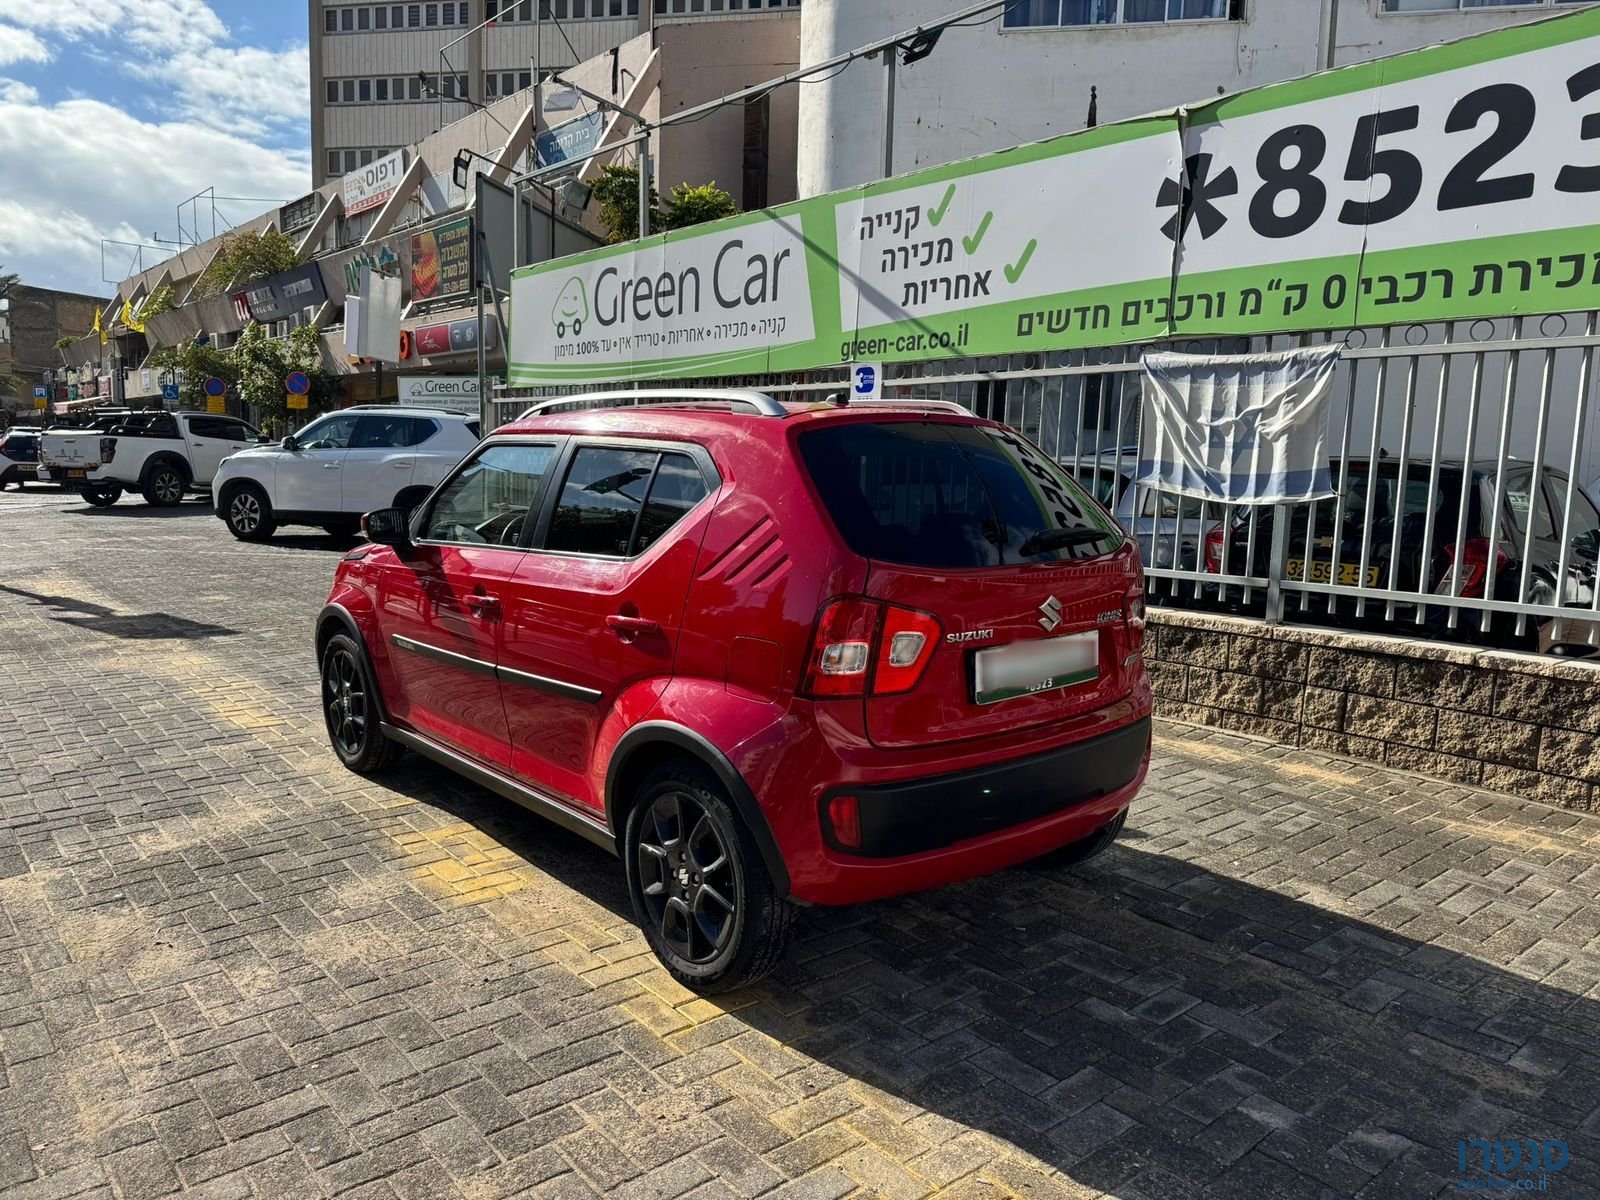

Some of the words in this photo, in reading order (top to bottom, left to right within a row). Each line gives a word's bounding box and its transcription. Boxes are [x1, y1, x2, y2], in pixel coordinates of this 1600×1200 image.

[366, 157, 397, 187] דפוס
[860, 205, 921, 240] קנייה
[882, 237, 953, 273] מכירה
[594, 267, 700, 327] Green
[712, 239, 791, 309] Car
[901, 270, 993, 307] אחריות
[1361, 268, 1454, 306] רכבי
[1468, 252, 1600, 297] כירת
[1322, 274, 1347, 309] 0
[1017, 304, 1111, 337] חדשים
[1121, 291, 1226, 326] ורכבים
[634, 332, 660, 349] טרייד
[667, 327, 705, 345] אחריות
[714, 321, 748, 339] מכירה
[758, 316, 786, 337] קניה
[841, 322, 969, 361] green-car.co.il
[554, 343, 575, 360] מימון
[576, 340, 600, 355] 100%
[601, 339, 612, 352] עד
[619, 335, 632, 354] אין
[425, 380, 460, 393] Green
[946, 628, 994, 644] SUZUKI
